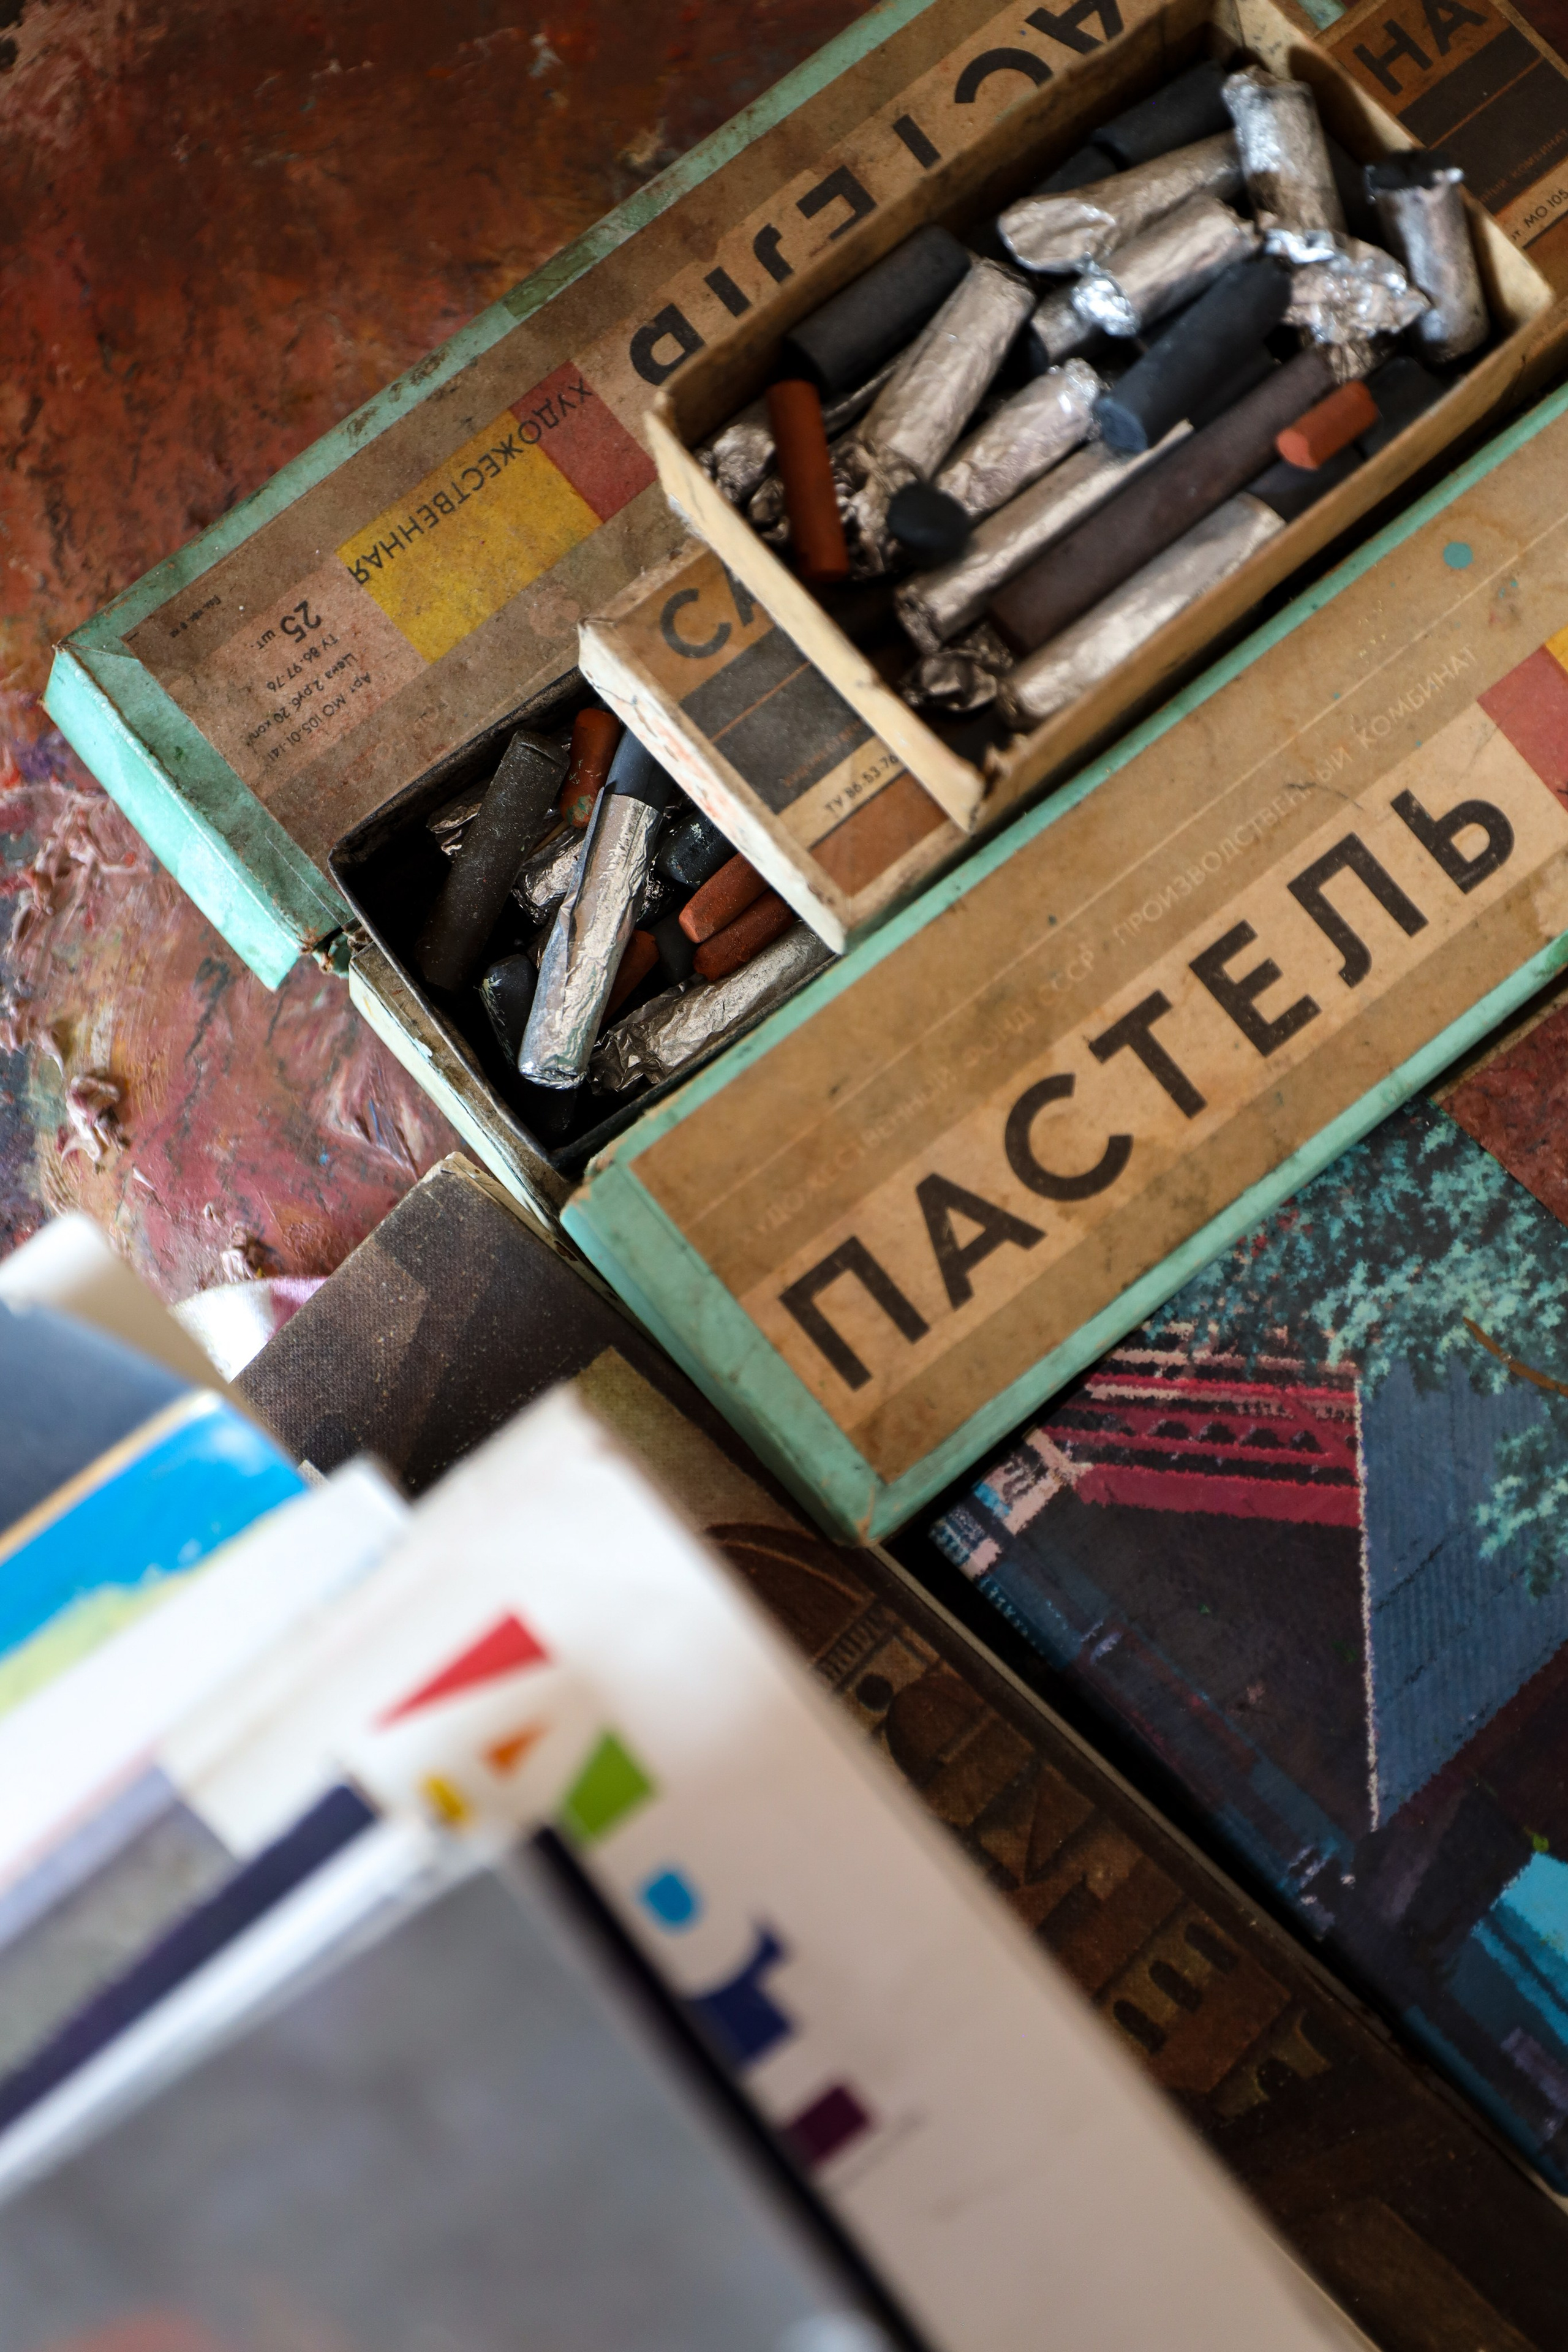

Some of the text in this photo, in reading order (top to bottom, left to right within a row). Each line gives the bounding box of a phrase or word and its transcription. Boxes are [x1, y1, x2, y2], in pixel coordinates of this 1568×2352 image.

[1524, 205, 1548, 228] МО
[347, 377, 593, 584] ХУДОЖЕСТВЕННАЯ
[251, 600, 321, 649] 25 шт.
[322, 633, 338, 650] ТУ
[325, 652, 358, 679] Цена
[273, 707, 290, 723] 20
[322, 693, 347, 717] МО
[962, 1005, 1036, 1069] ФОНД
[1112, 745, 1353, 946] ПРОИЗВОДСТВЕНЫЙ
[1355, 645, 1479, 749] КОМБИНАТ
[778, 789, 1515, 1392] ПАСТЕЛЬ
